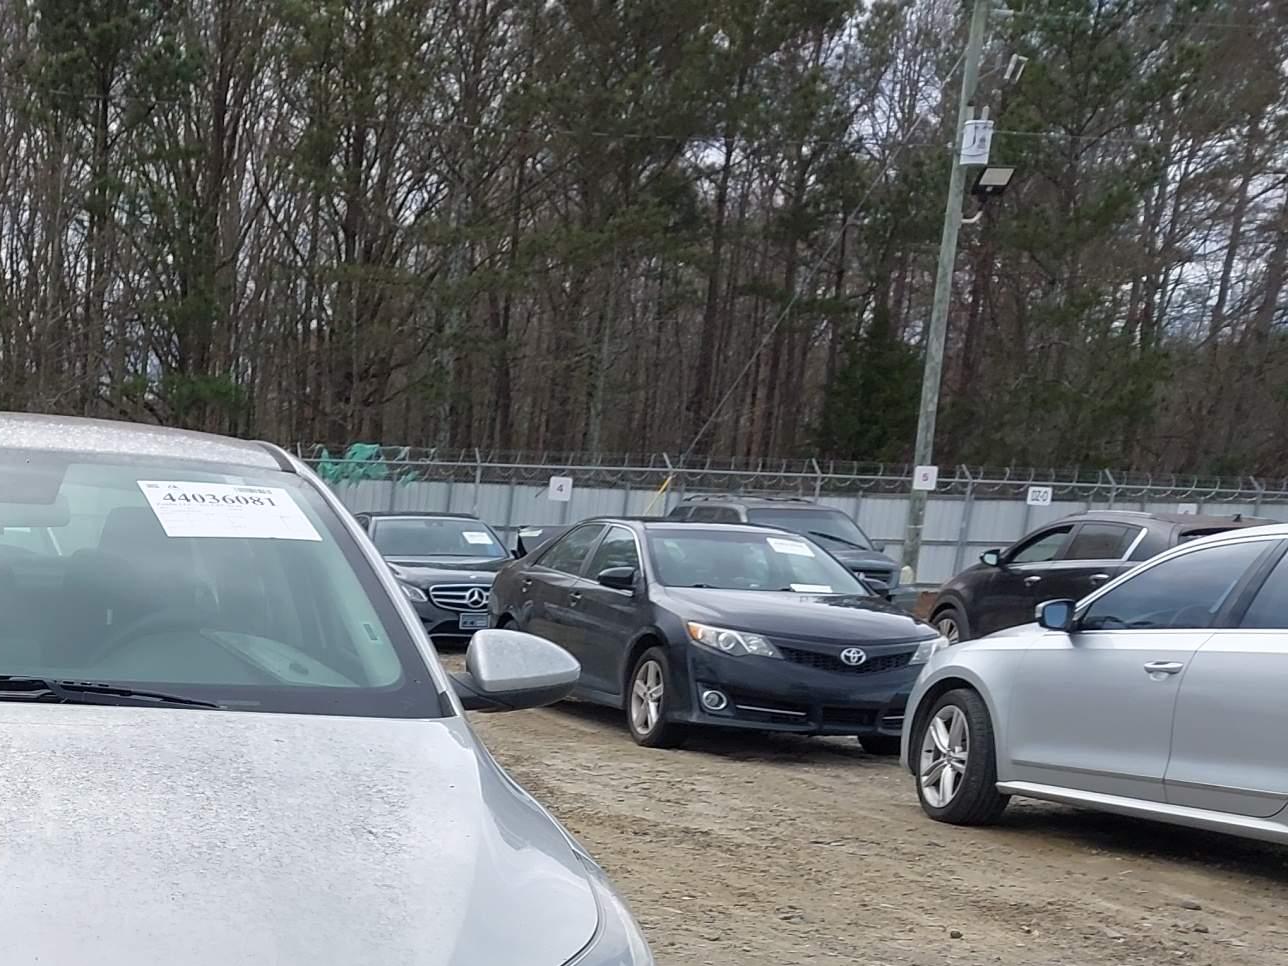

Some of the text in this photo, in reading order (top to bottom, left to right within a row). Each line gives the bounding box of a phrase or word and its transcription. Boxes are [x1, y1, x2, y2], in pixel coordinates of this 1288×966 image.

[922, 472, 929, 482] 5
[556, 484, 564, 492] 4
[162, 492, 277, 507] 44036081
